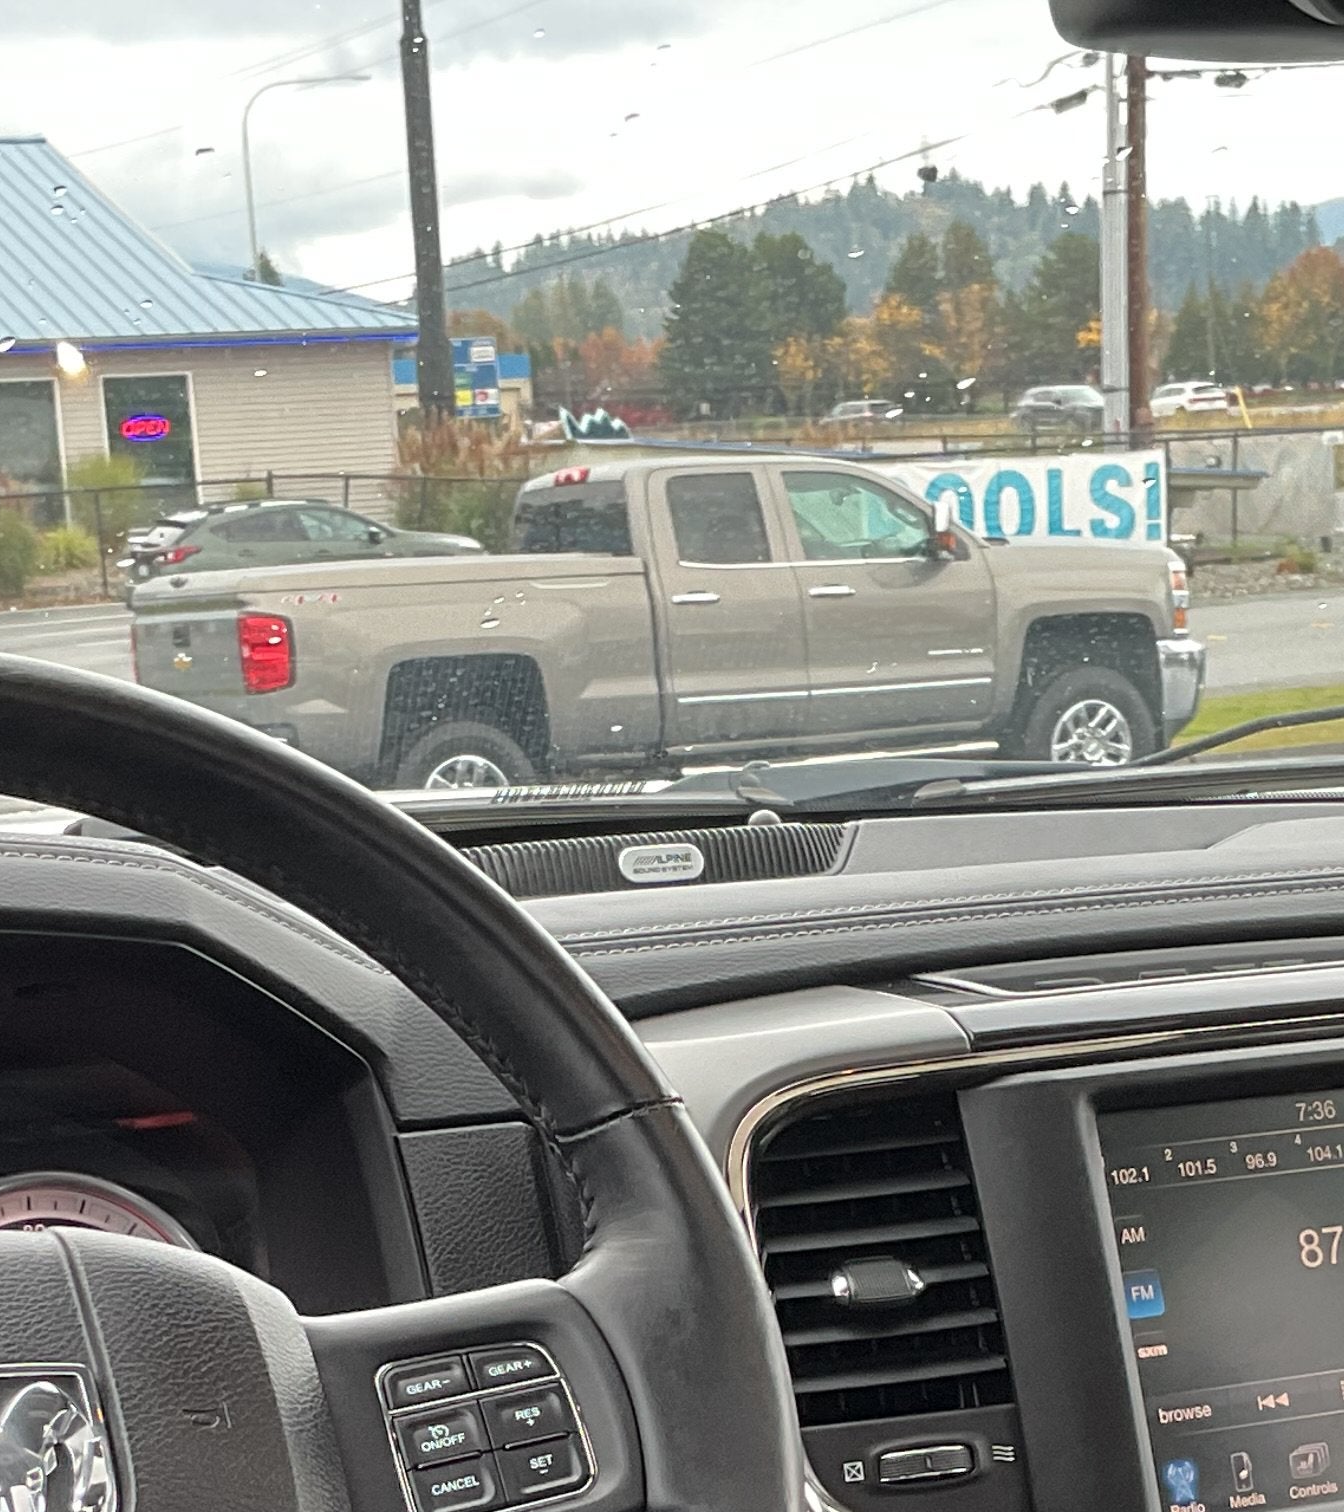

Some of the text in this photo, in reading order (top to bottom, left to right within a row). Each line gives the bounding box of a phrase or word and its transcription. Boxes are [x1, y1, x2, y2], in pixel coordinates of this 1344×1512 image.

[120, 418, 171, 437] OPEN
[901, 461, 1161, 542] OOLS!
[642, 853, 692, 865] ALPINE
[1295, 1100, 1336, 1122] 7:36
[1230, 1141, 1238, 1153] 3
[1294, 1134, 1302, 1146] 4
[1164, 1149, 1173, 1162] 2
[1245, 1153, 1277, 1171] 96.9
[1306, 1144, 1344, 1162] 104.1
[1111, 1167, 1151, 1186] 102.1
[1177, 1159, 1217, 1178] 101.5
[1121, 1227, 1146, 1245] AM
[1131, 1285, 1155, 1303] FM
[515, 1406, 540, 1421] RES
[1158, 1404, 1212, 1424] browse
[421, 1433, 465, 1452] ON/OFF
[530, 1454, 553, 1469] SET
[431, 1476, 480, 1496] CANCEL
[1289, 1481, 1338, 1499] Controls
[1229, 1492, 1267, 1509] Media
